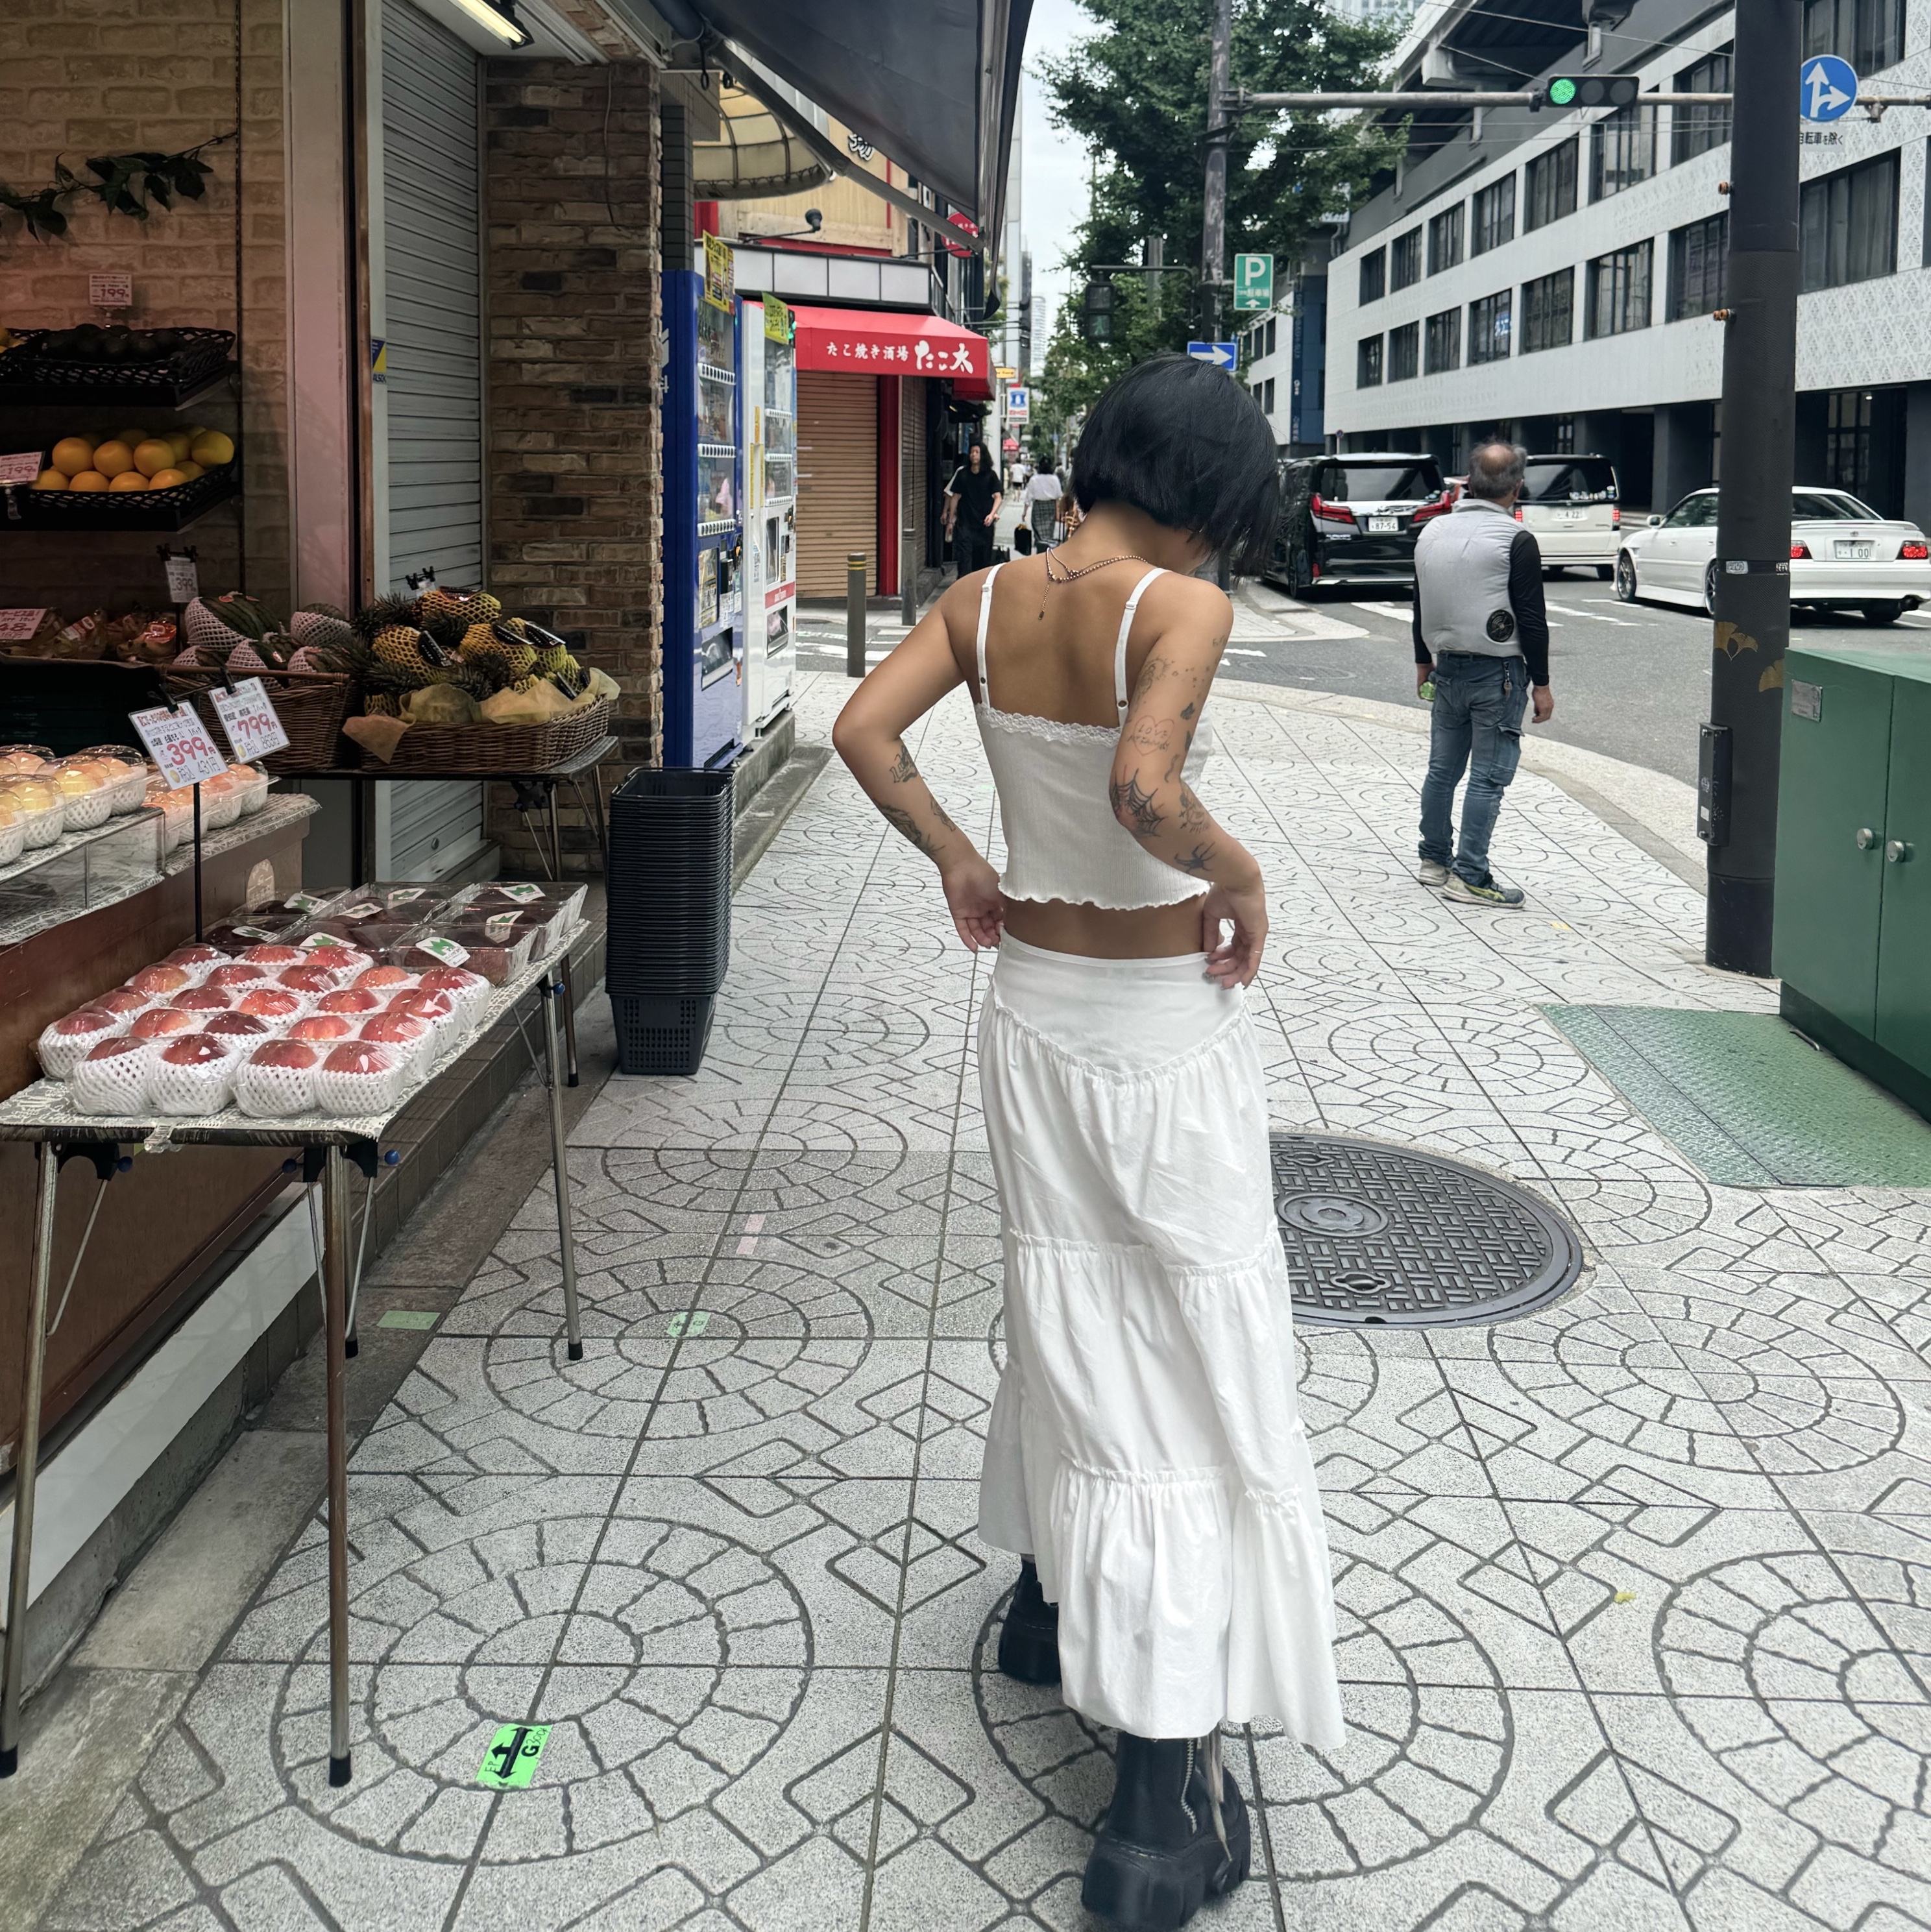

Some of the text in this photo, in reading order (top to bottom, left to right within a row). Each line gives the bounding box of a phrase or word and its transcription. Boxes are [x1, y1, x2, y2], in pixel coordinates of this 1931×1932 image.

[1245, 257, 1266, 286] P
[826, 339, 974, 374] たこ焼き酒場 たこ太
